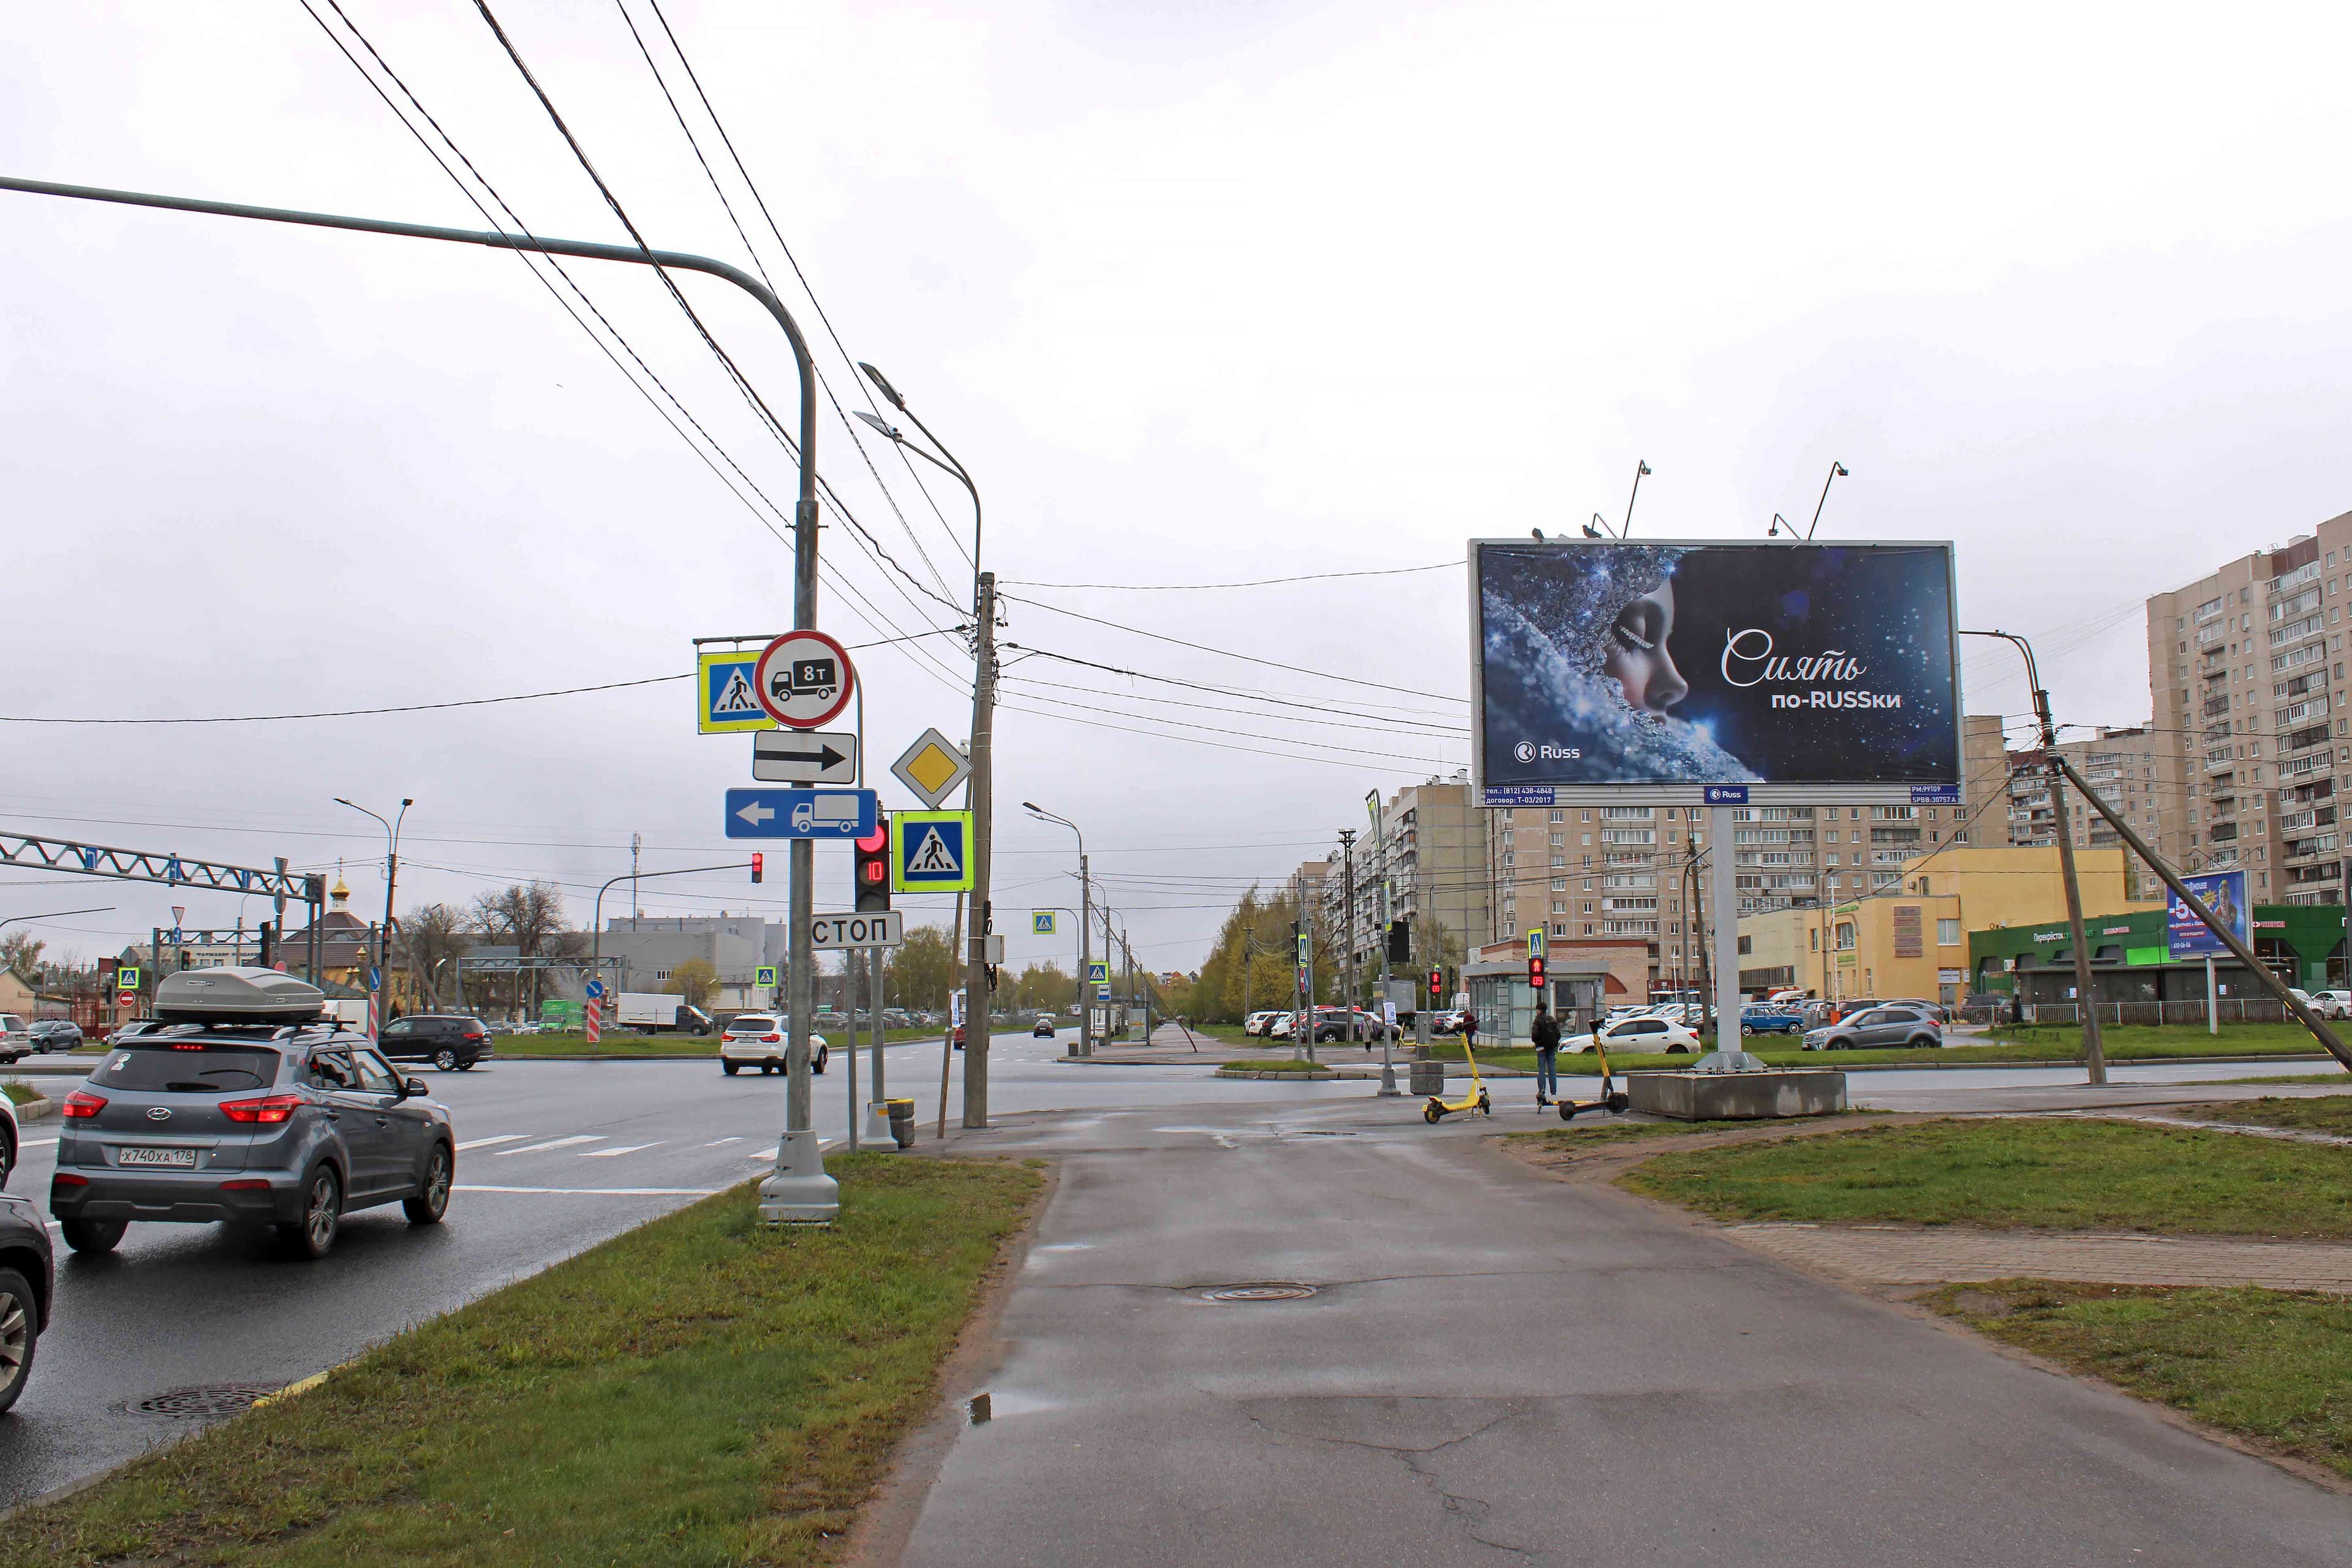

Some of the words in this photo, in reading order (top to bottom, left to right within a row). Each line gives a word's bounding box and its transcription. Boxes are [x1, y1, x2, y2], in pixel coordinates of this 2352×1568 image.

[1721, 627, 1868, 687] Сиять
[1771, 691, 1902, 709] по-RUSSки
[1540, 745, 1580, 759] Russ
[868, 862, 883, 880] 10
[2193, 881, 2207, 890] HOUSE
[812, 918, 887, 944] СТОП
[1532, 976, 1543, 985] 09
[174, 1150, 190, 1160] 178
